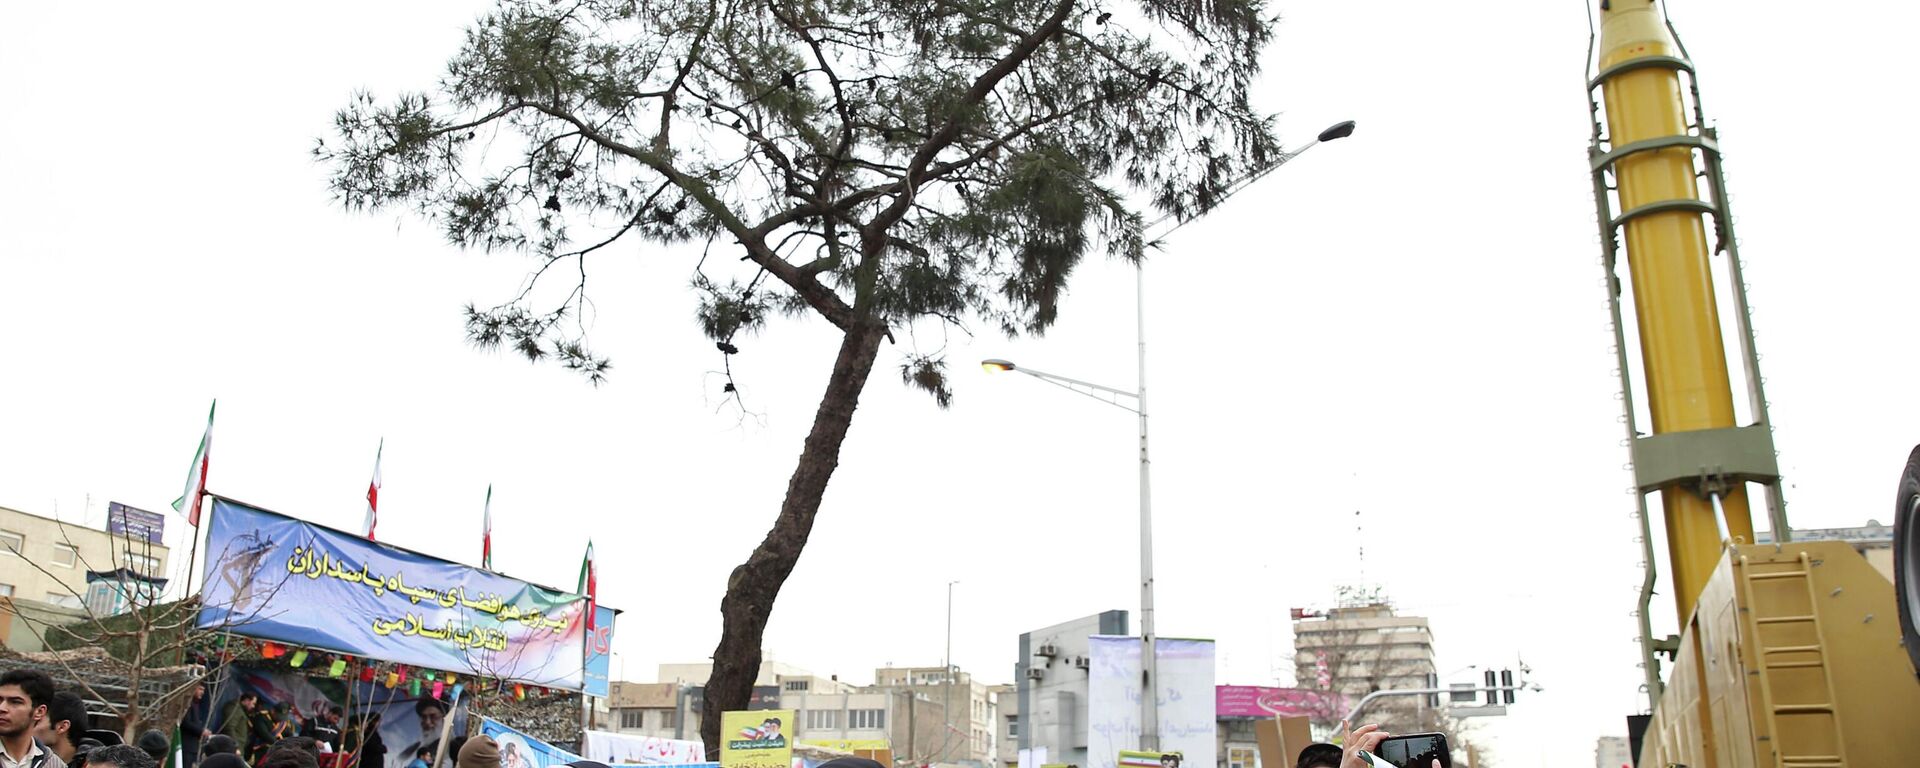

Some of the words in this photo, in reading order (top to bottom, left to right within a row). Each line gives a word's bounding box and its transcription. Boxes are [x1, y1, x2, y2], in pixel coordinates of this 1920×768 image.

[286, 546, 386, 597] پاسداران
[387, 571, 437, 604] سپاه
[372, 611, 452, 641] اسلامی
[520, 607, 568, 634] نیروی
[453, 624, 508, 651] انقلاب
